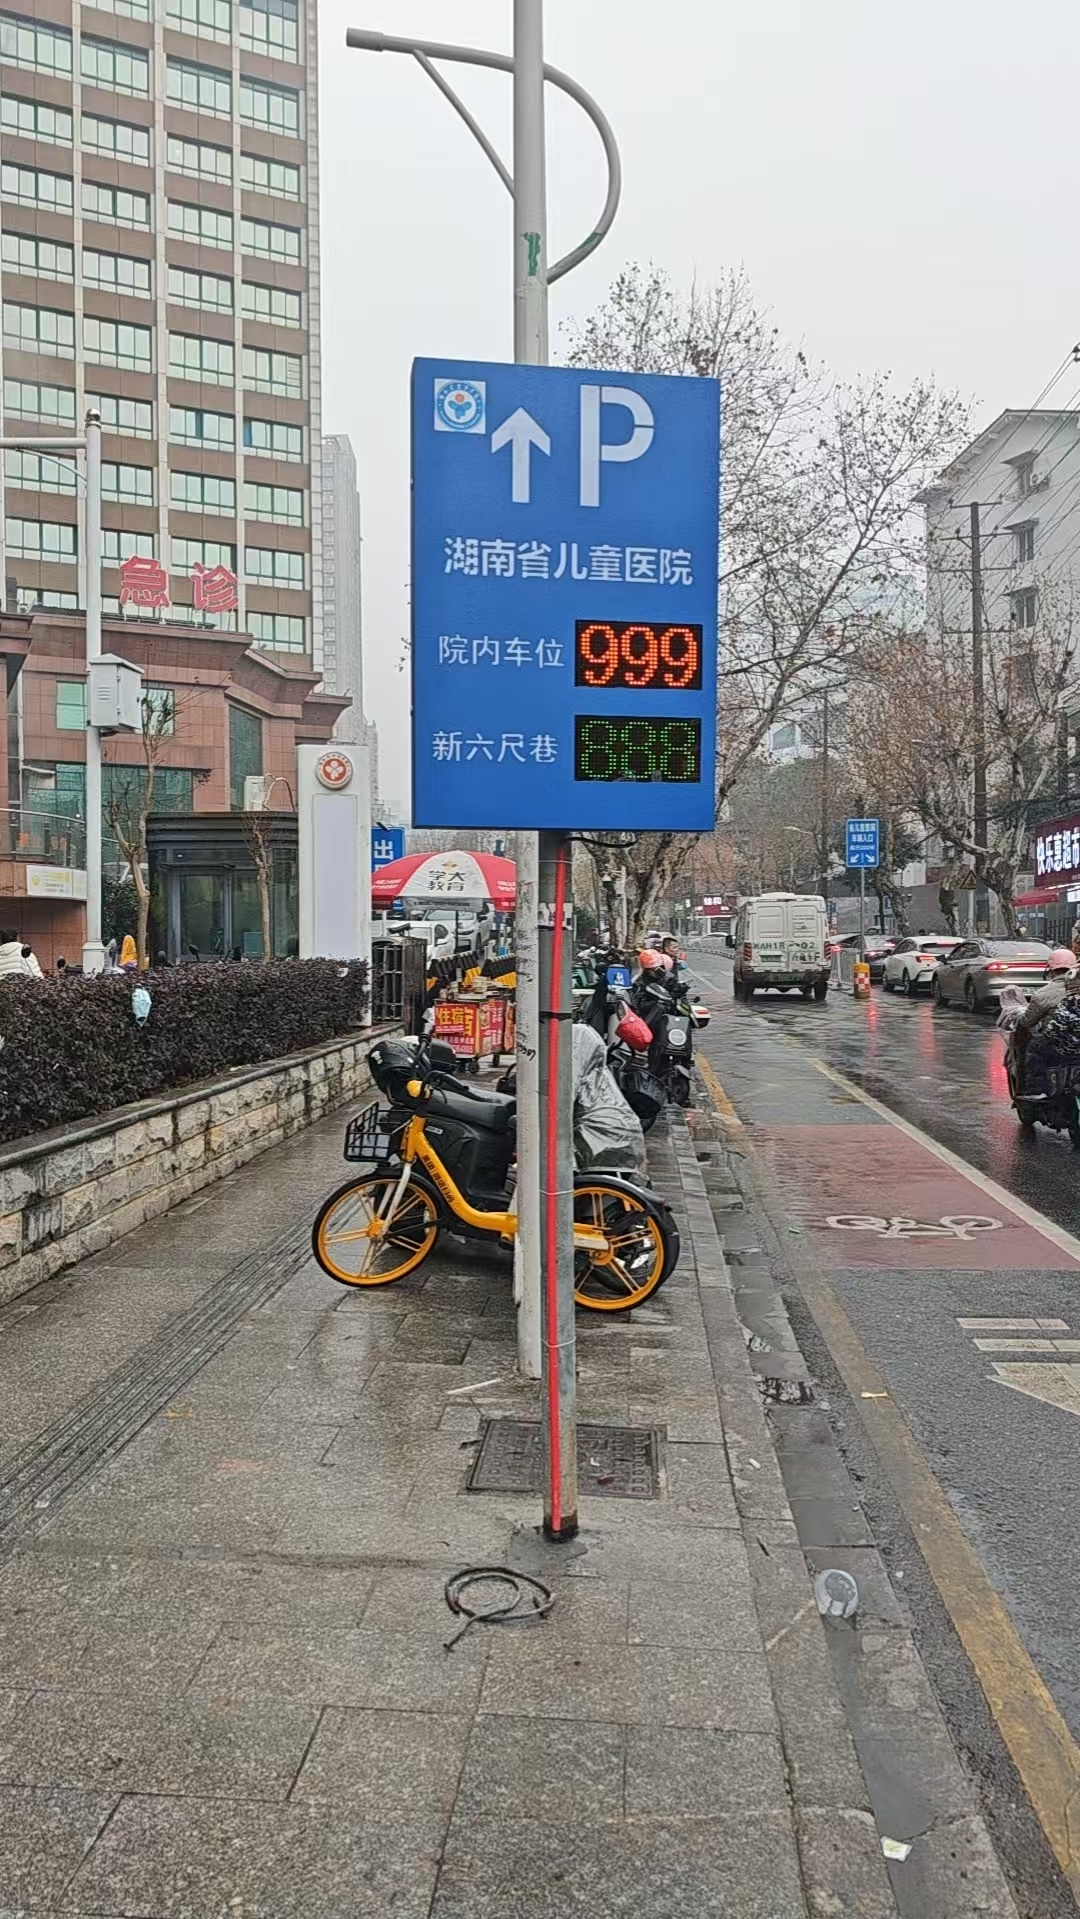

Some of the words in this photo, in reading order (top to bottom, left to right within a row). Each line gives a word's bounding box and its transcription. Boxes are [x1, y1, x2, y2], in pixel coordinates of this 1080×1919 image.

[579, 384, 656, 508] P
[443, 536, 694, 586] 湖南省儿童医院
[119, 555, 240, 614] 急诊
[438, 633, 566, 669] 院内车位
[580, 624, 698, 688] 999
[431, 730, 559, 763] 新六尺巷
[580, 719, 697, 780] 888
[373, 839, 394, 872] 出
[428, 870, 466, 881] 学大
[427, 881, 465, 892] 教育
